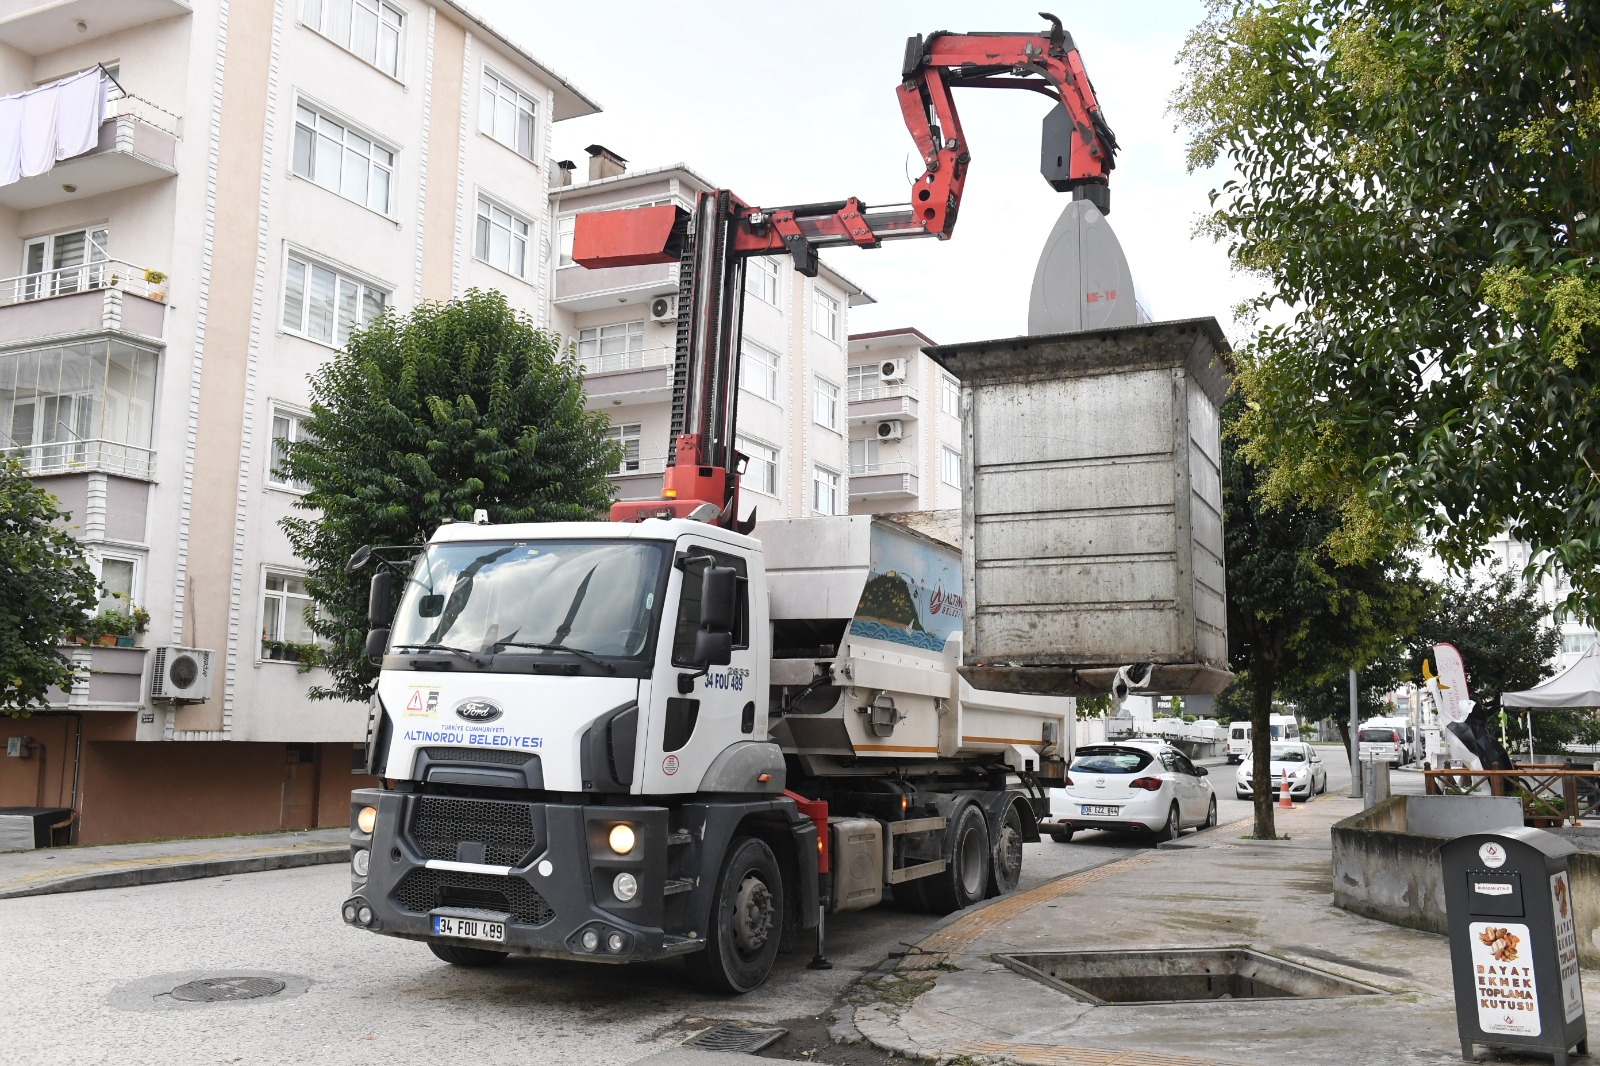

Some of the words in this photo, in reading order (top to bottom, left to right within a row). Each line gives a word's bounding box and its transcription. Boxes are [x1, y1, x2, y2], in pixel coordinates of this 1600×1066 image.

[728, 667, 749, 677] 2633
[704, 672, 713, 688] 34
[715, 673, 729, 689] FOU
[731, 676, 743, 691] 489
[463, 702, 491, 717] Ford
[403, 730, 464, 744] ALTINORDU
[468, 733, 543, 748] BELEDİYESİ
[440, 919, 453, 934] 34
[457, 920, 478, 936] FOU
[482, 923, 503, 939] 489
[1476, 964, 1530, 977] BAYAT
[1478, 975, 1532, 988] EKMEK
[1479, 987, 1534, 1000] TOPLAMA
[1480, 998, 1534, 1012] KUTUSU
